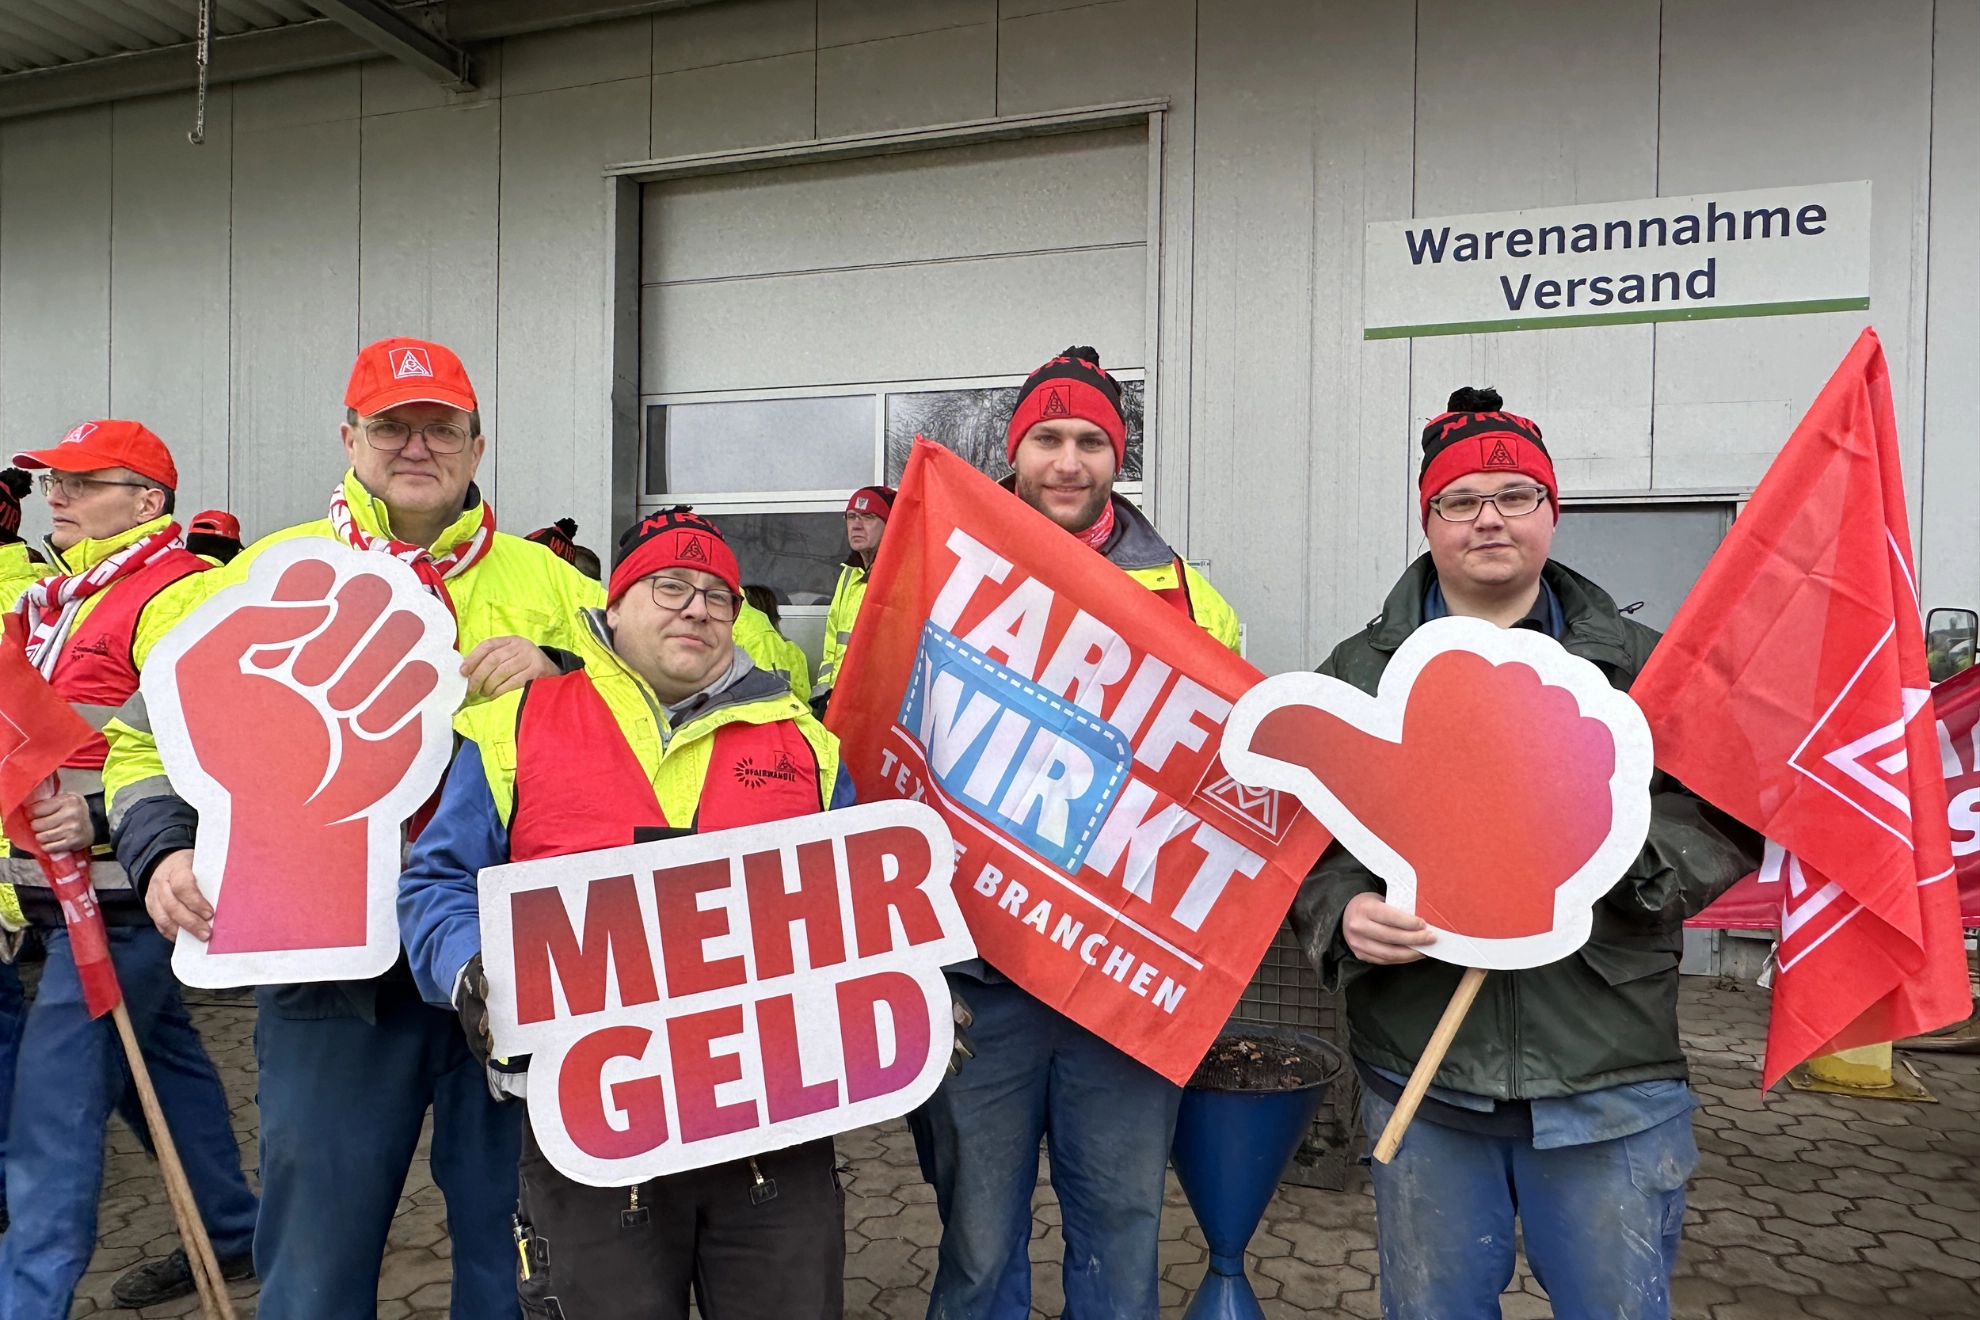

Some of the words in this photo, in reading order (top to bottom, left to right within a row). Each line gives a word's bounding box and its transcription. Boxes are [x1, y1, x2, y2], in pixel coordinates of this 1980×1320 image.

[1405, 202, 1827, 265] Warenannahme
[1500, 257, 1717, 311] Versand
[929, 527, 1233, 773] TARIF
[919, 650, 1267, 932] WIRKT
[510, 826, 945, 1025] MEHR
[973, 862, 1187, 1015] BRANCHEN
[558, 970, 931, 1160] GELD
